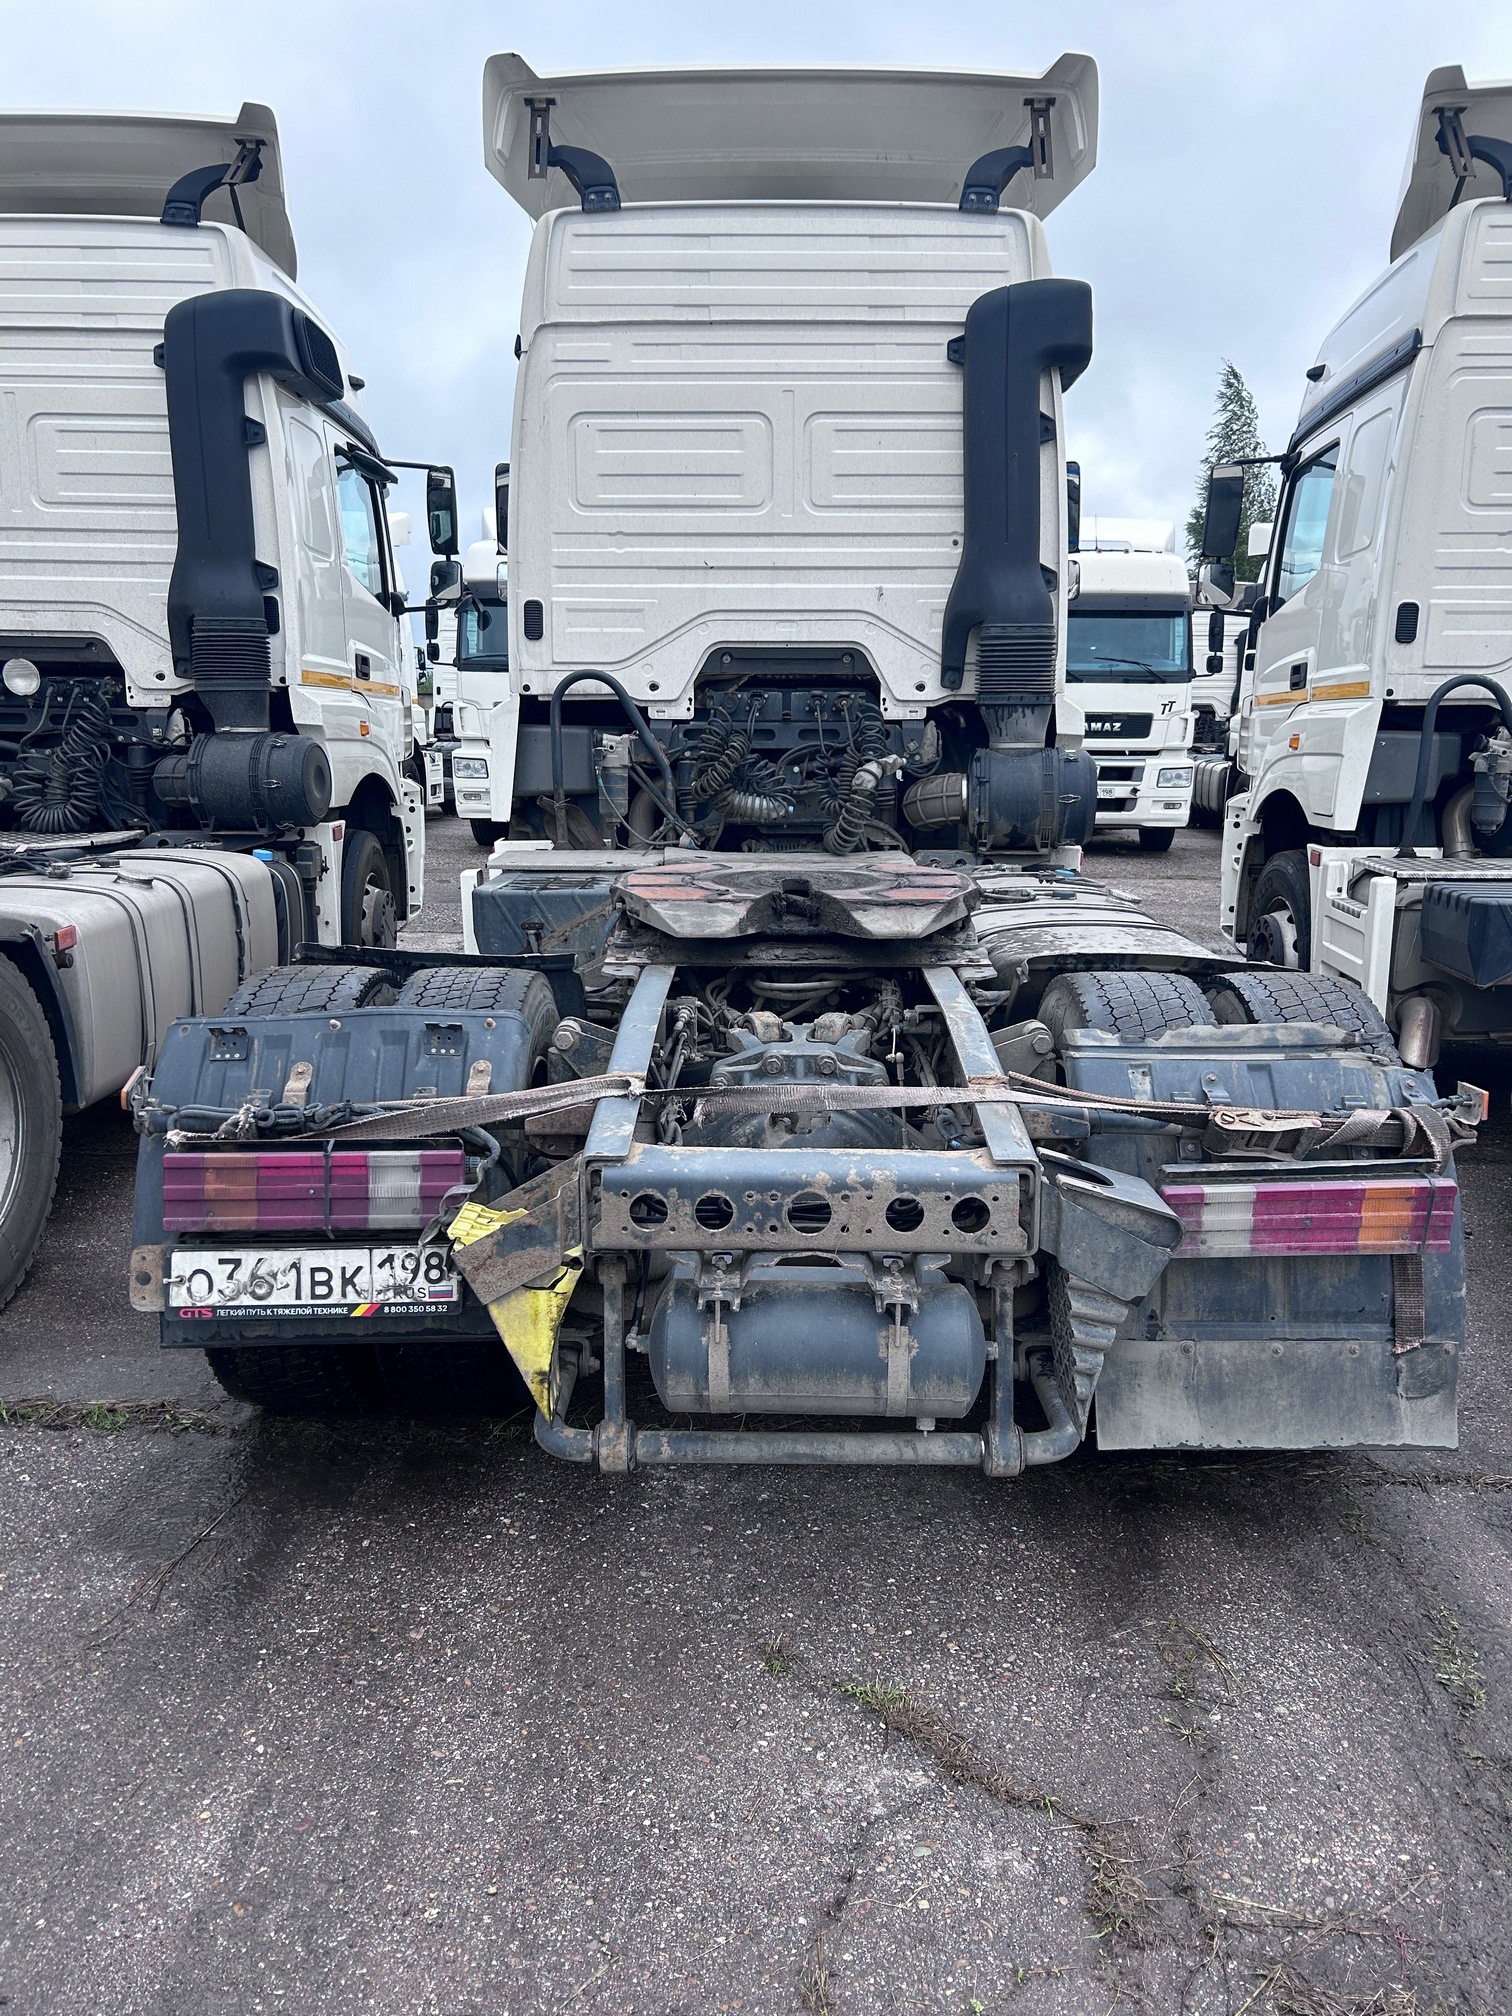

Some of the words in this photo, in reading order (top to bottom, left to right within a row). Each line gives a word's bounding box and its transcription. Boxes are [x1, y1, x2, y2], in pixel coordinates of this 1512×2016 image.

[1084, 722, 1121, 731] AMAZ
[377, 1251, 444, 1284] 198
[179, 1308, 213, 1318] GTS
[216, 1307, 246, 1317] ЛЕГКИЙ
[246, 1308, 266, 1316] ПУТЬ
[266, 1308, 273, 1316] К
[273, 1306, 314, 1316] ТЯЖЕЛОЙ
[314, 1307, 348, 1315] ТЕХНИКЕ
[384, 1305, 389, 1313] 8
[390, 1305, 408, 1313] 800
[408, 1304, 424, 1313] 350
[425, 1304, 437, 1312] 58
[437, 1304, 448, 1312] 32
